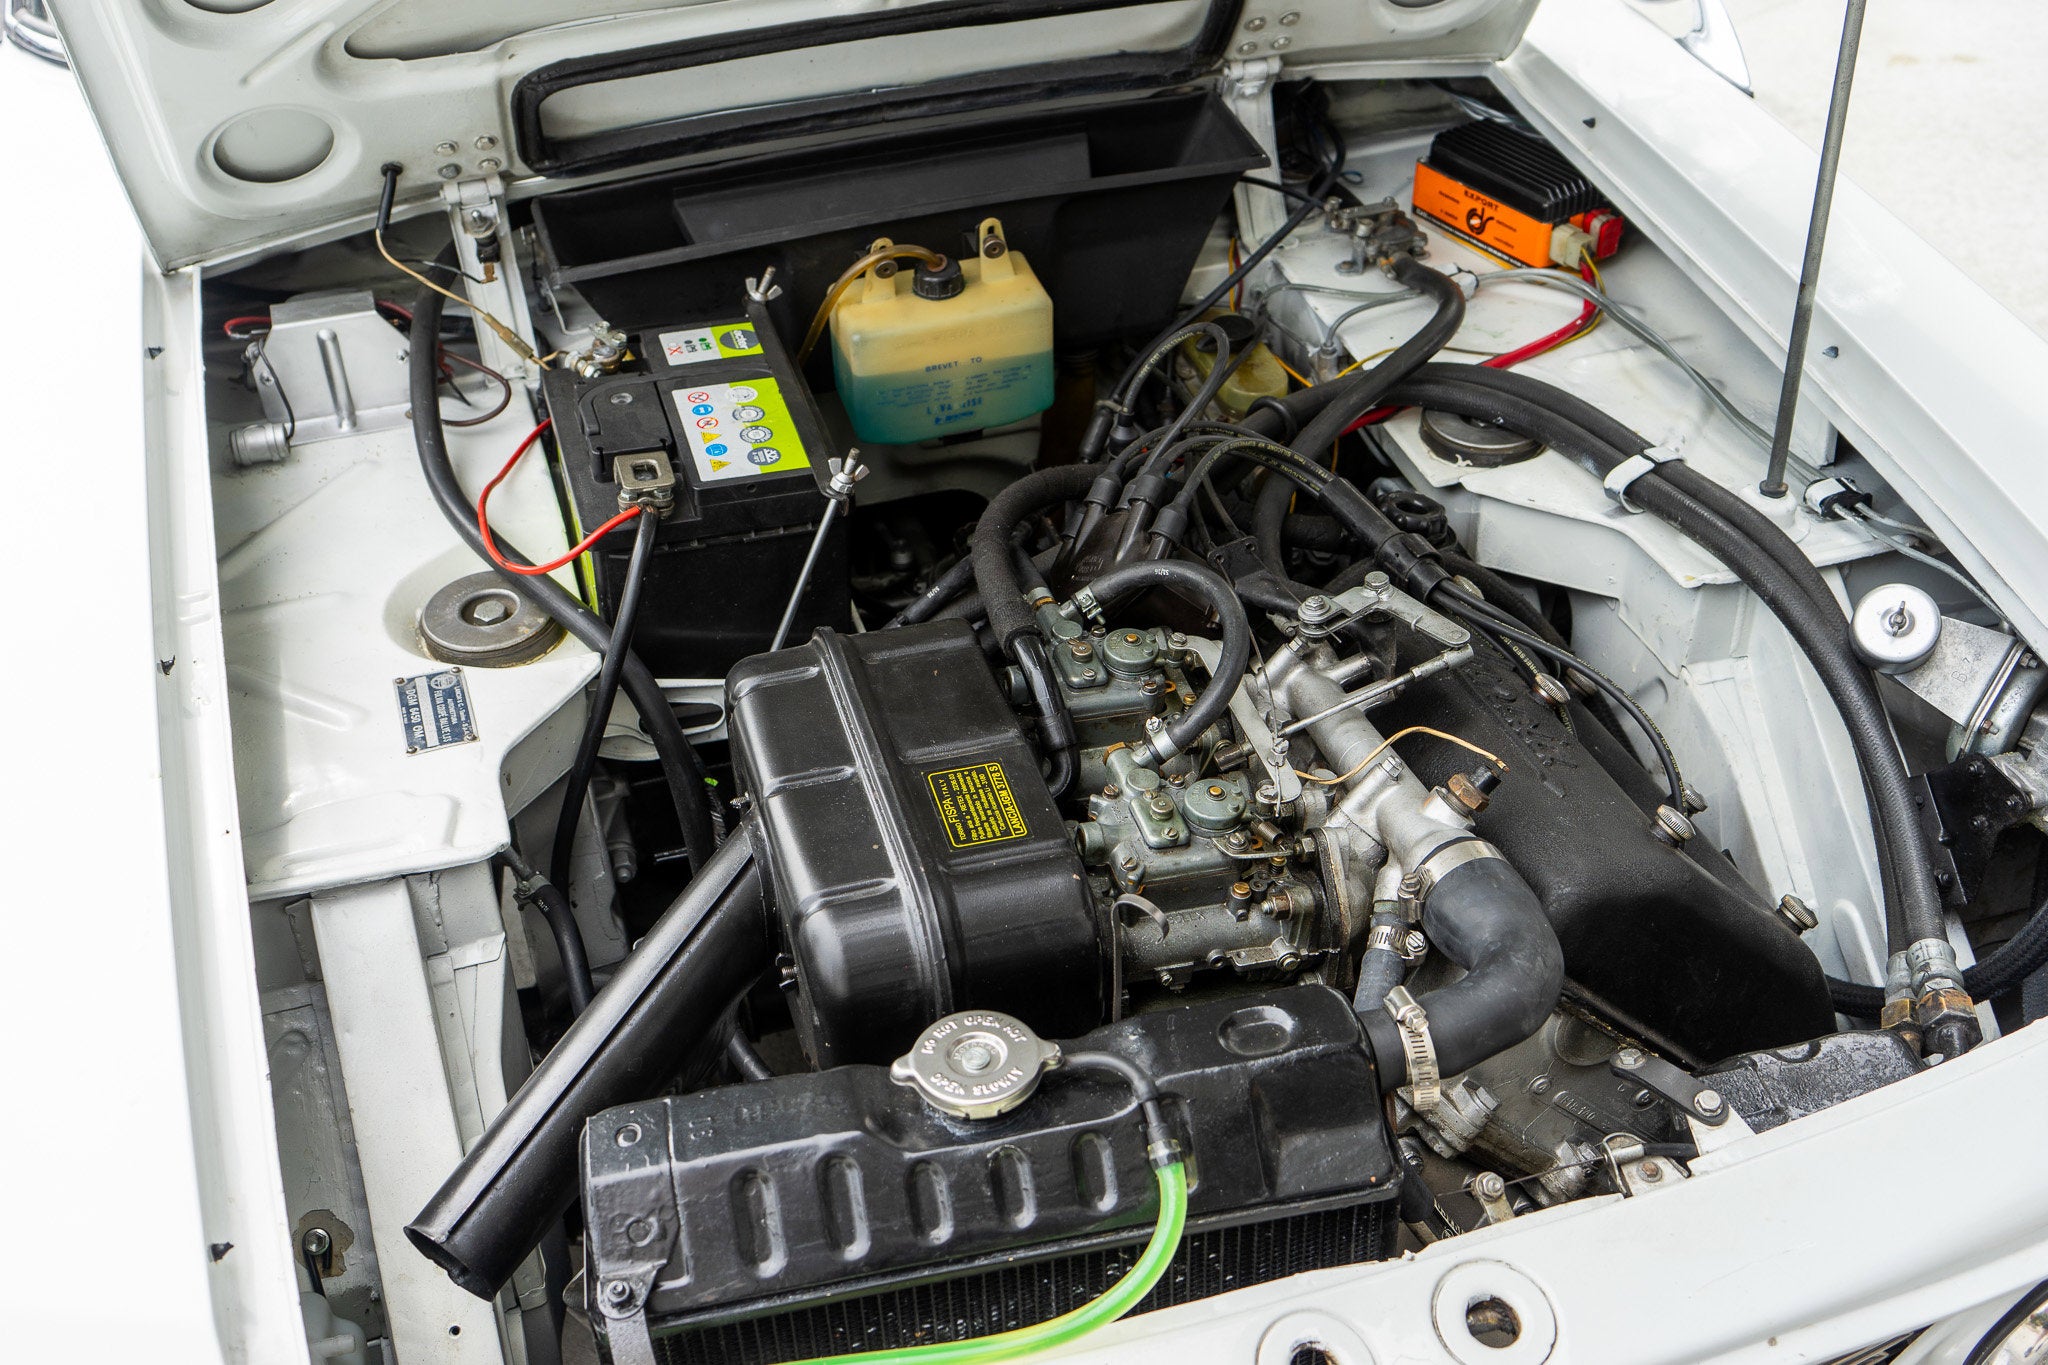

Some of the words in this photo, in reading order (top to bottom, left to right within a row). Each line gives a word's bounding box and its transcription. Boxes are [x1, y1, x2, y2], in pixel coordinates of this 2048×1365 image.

[1464, 190, 1498, 210] EXPORT
[405, 688, 418, 705] DGM
[408, 707, 421, 723] 6450
[412, 724, 424, 738] OM
[939, 779, 950, 797] ITALY
[991, 772, 1005, 789] 3778
[942, 798, 960, 823] FISPA
[997, 789, 1024, 833] LANCIA-IGM
[955, 822, 967, 840] TORINO
[933, 1020, 958, 1039] NOT
[963, 1015, 1001, 1029] OPEN
[930, 1072, 966, 1096] OPEN
